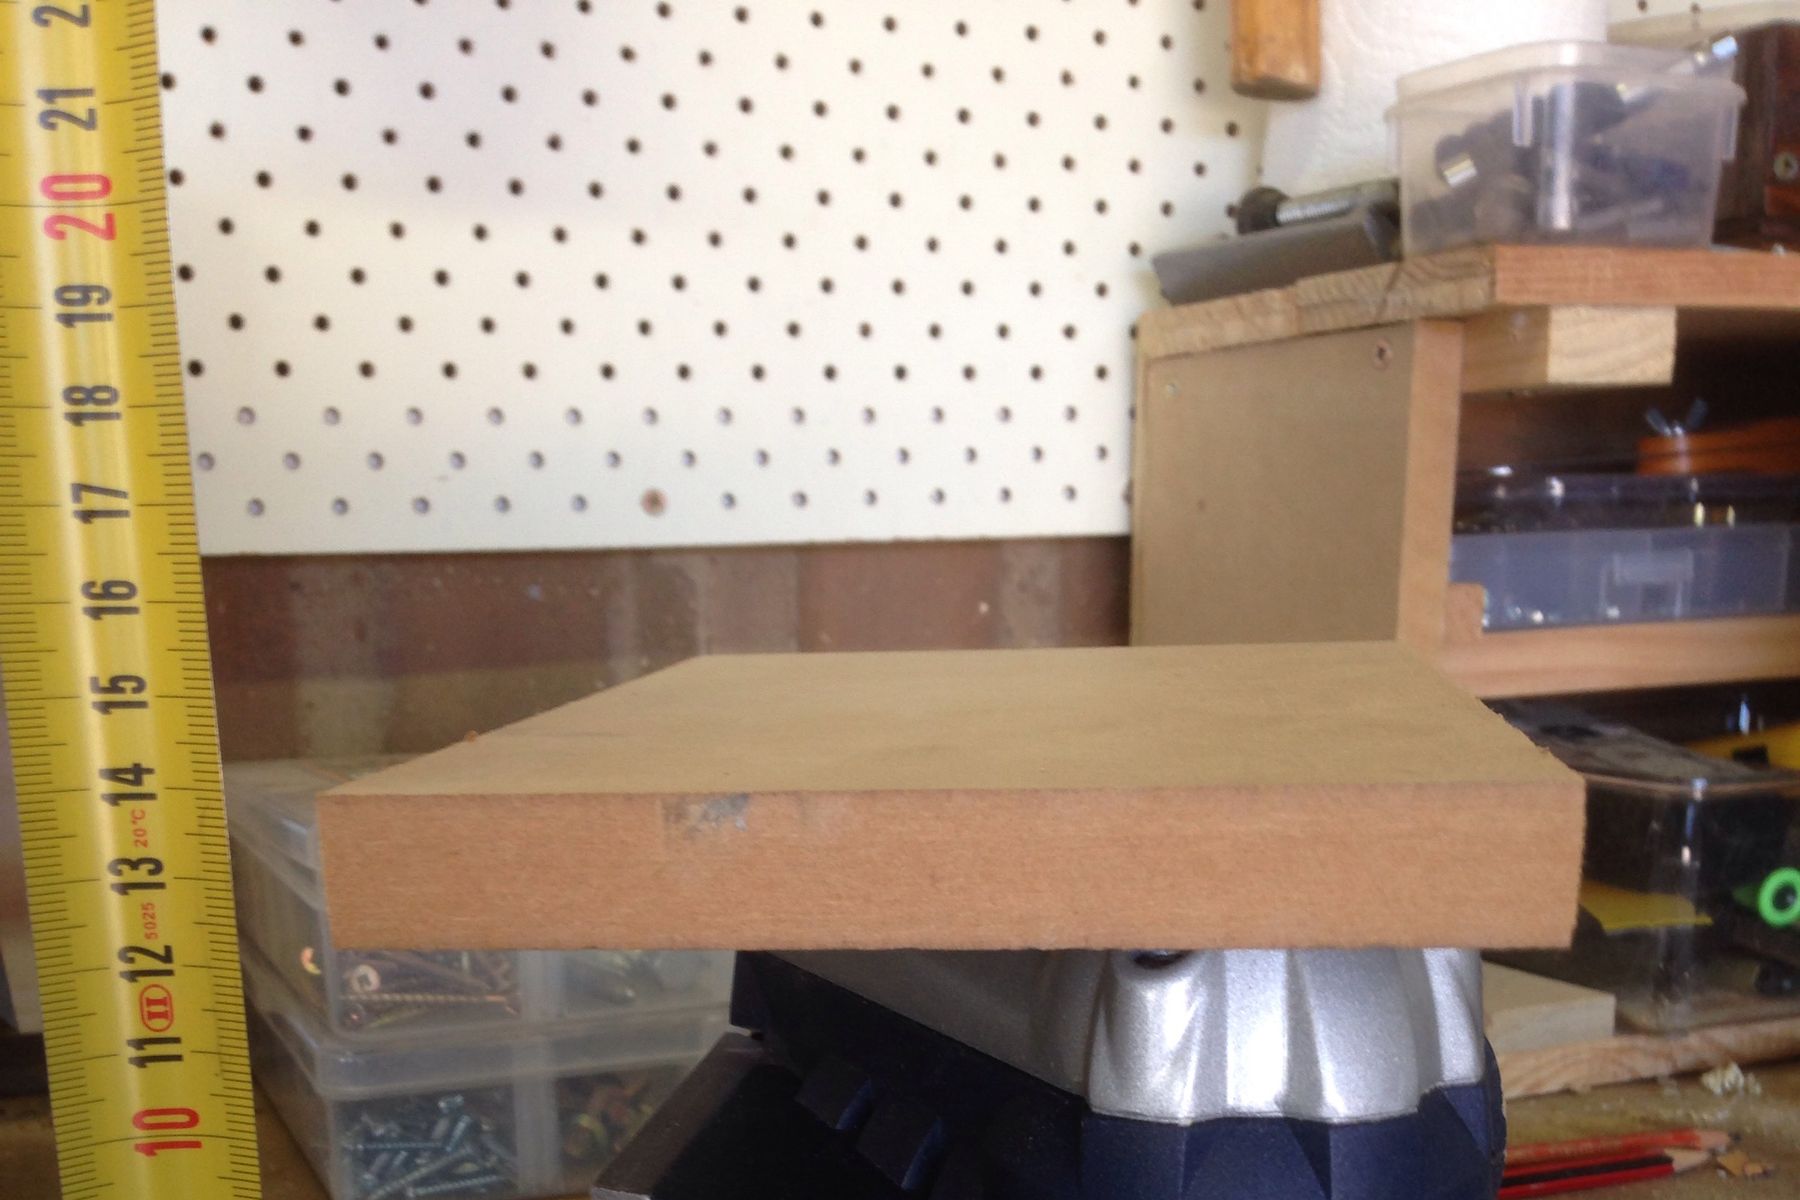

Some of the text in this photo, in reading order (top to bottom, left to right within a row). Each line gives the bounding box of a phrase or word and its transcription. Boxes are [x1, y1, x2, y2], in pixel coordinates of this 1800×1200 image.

[33, 5, 90, 27] 2
[37, 88, 97, 131] 21
[41, 173, 117, 241] 20
[54, 284, 114, 329] 19
[62, 384, 122, 427] 18
[70, 482, 131, 524] 17
[80, 579, 140, 621] 16
[89, 673, 150, 716] 15
[98, 762, 158, 807] 14
[107, 856, 167, 897] 13
[142, 902, 159, 940] 5025
[117, 944, 175, 984] 12
[126, 1036, 184, 1069] 11
[132, 1107, 202, 1158] 10
